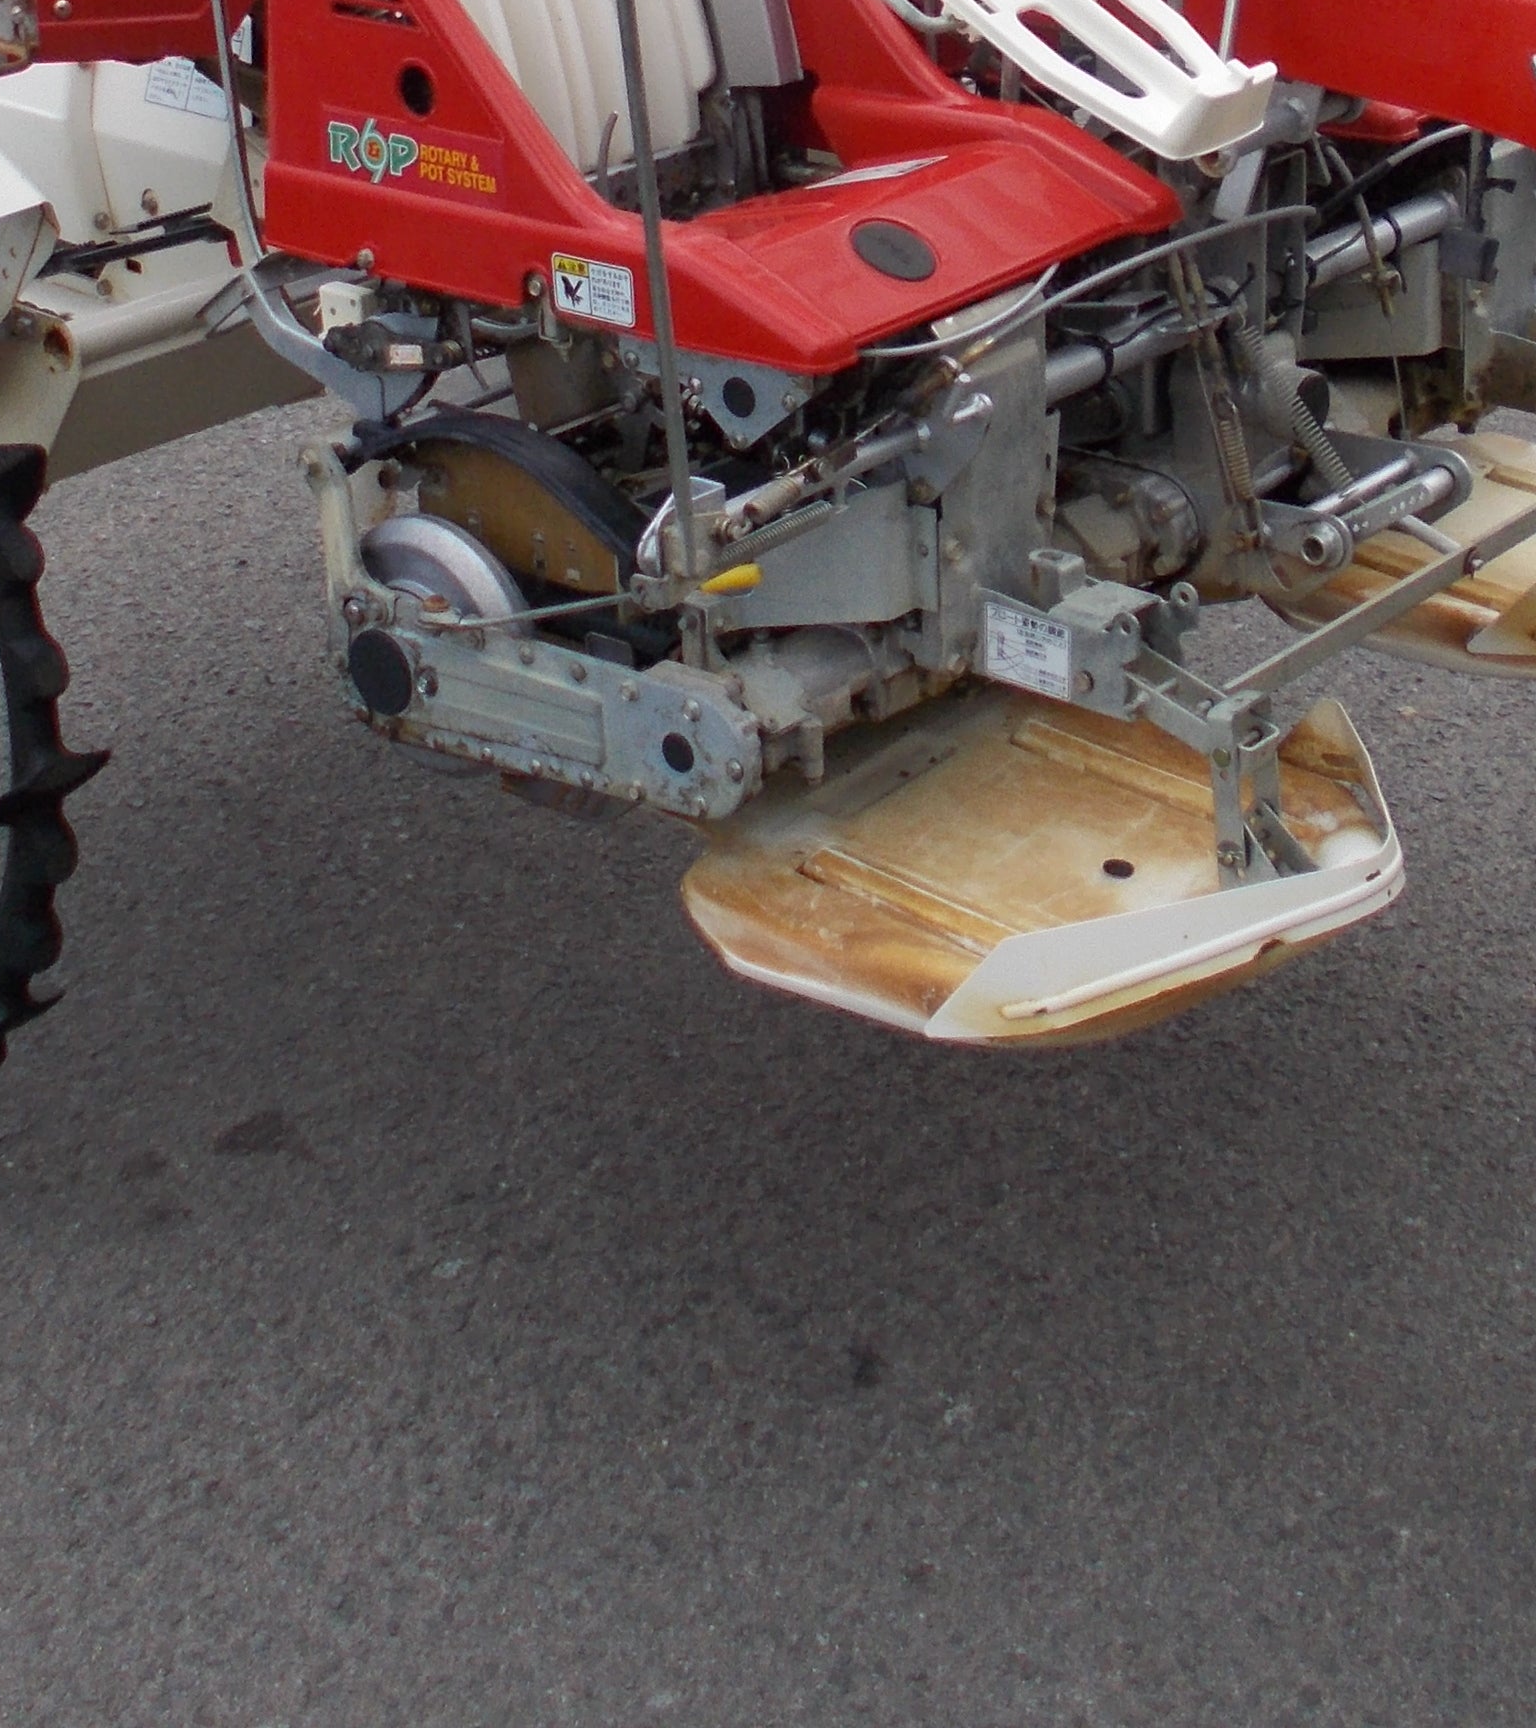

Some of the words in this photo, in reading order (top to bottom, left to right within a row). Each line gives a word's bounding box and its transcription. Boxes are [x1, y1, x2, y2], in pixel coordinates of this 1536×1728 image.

[419, 144, 468, 168] ROTARY
[470, 154, 479, 172] &
[419, 162, 445, 182] POT
[447, 167, 498, 194] SYSTEM
